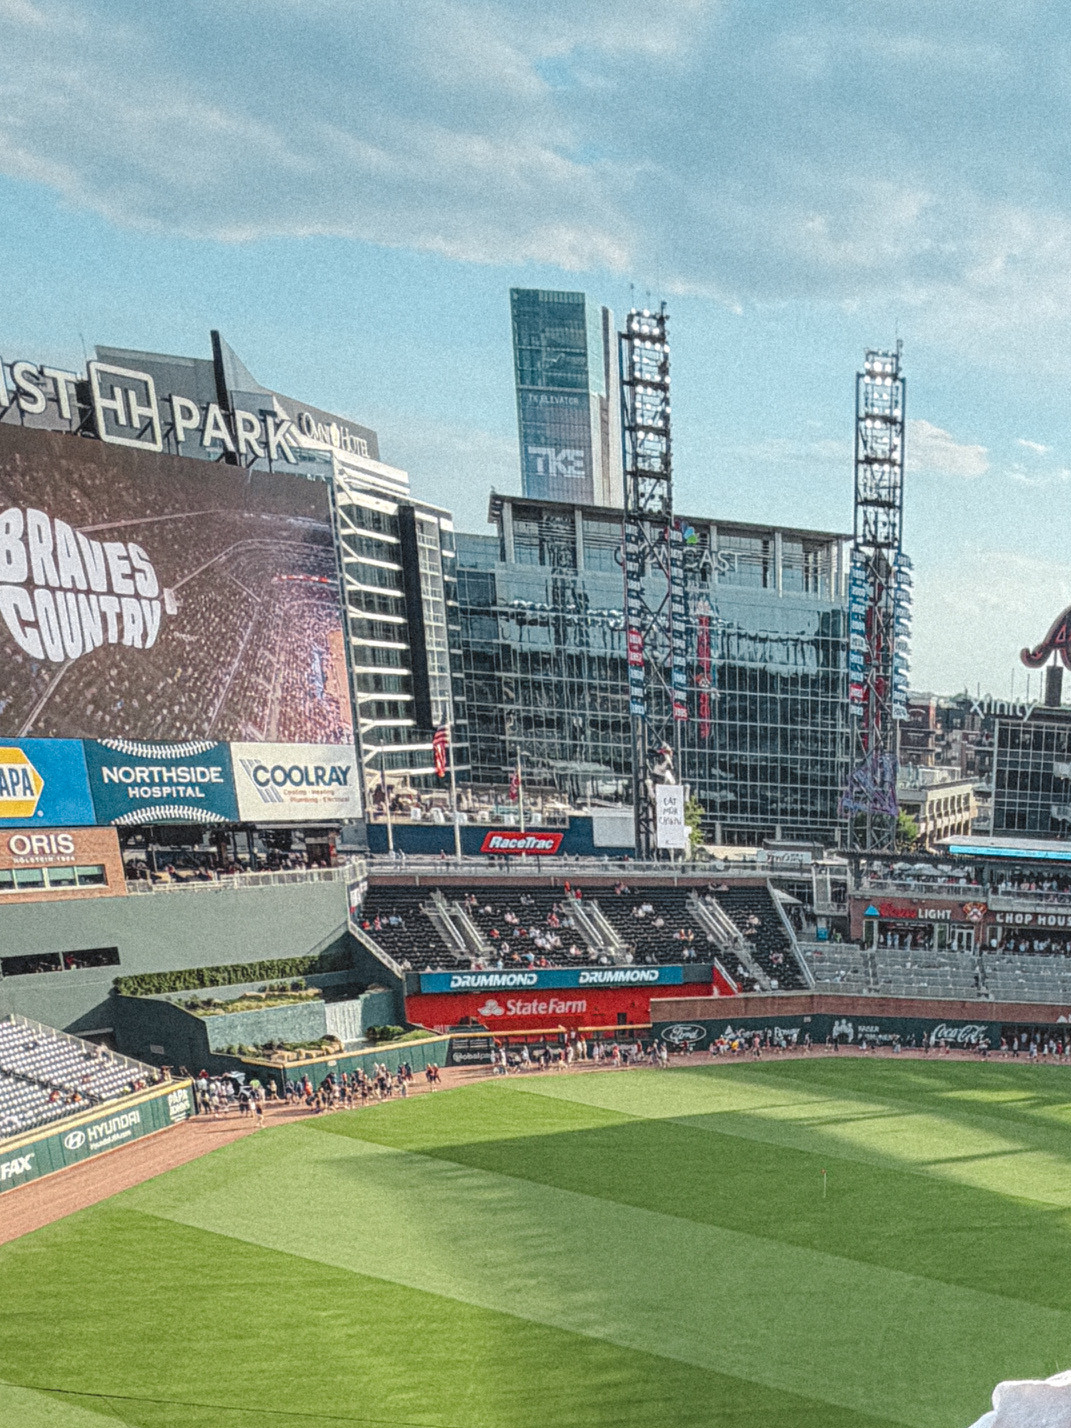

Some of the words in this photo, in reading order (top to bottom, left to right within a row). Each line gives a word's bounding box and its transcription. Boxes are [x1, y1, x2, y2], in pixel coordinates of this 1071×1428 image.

[171, 395, 301, 464] PARK
[340, 425, 370, 459] HOTEL
[528, 446, 585, 478] TKE
[0, 507, 159, 598] BRAVES
[0, 585, 161, 662] COUNTRY
[970, 693, 1038, 722] xfinity
[102, 766, 224, 784] NORTHSIDE
[252, 764, 351, 787] COOLRAY
[128, 785, 205, 799] HOSPITAL
[9, 833, 75, 855] ORIS
[488, 835, 554, 849] RaceTrac
[918, 908, 952, 919] LIGHT
[996, 912, 1033, 926] CHOP
[450, 973, 537, 988] DRUMMOND
[579, 969, 659, 984] DRUMMOND
[668, 1026, 699, 1042] Ford
[87, 1110, 141, 1141] HYUNDAI
